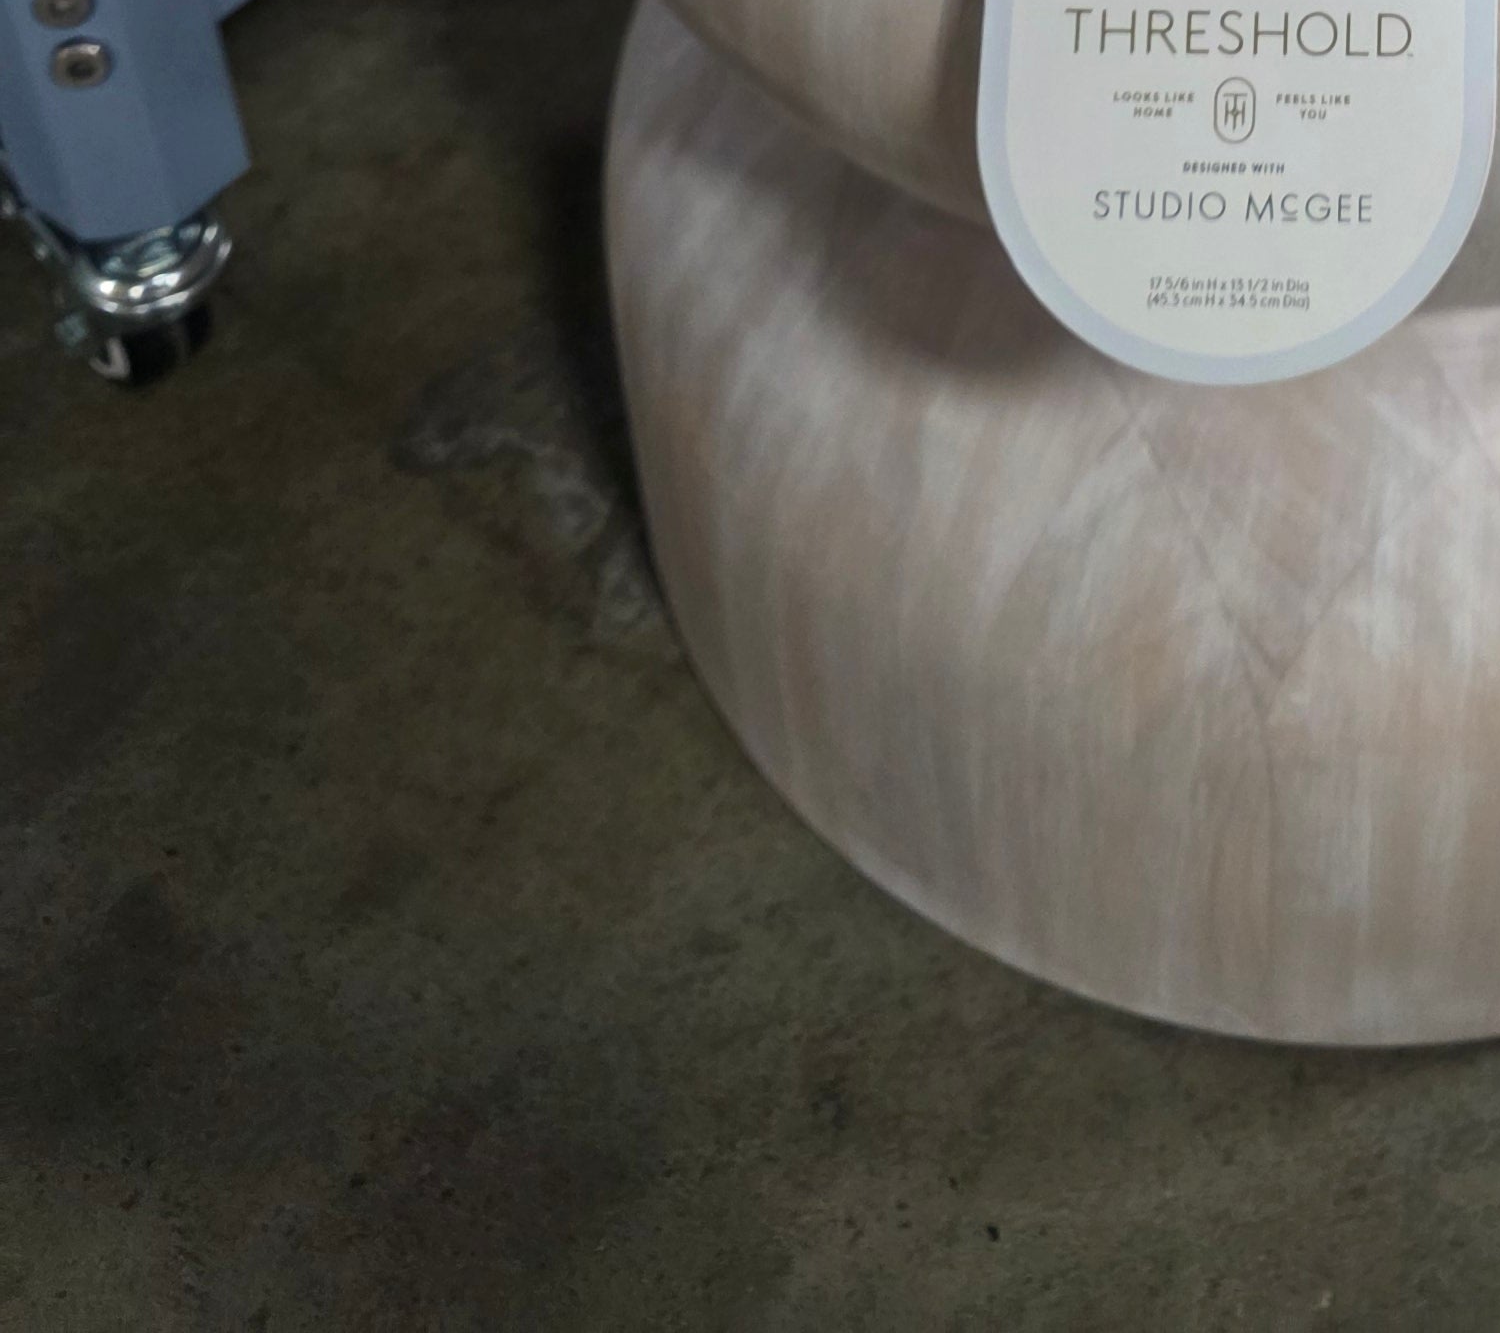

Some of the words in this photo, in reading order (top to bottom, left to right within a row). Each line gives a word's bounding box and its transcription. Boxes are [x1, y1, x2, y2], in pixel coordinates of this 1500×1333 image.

[1063, 7, 1413, 58] THRESHOLD
[1112, 91, 1160, 104] LOOKS
[1164, 91, 1196, 104] LIKE
[1275, 92, 1317, 106] FEELS
[1320, 93, 1351, 106] LIKE
[1133, 106, 1173, 119] HOME
[1299, 108, 1327, 121] YOU
[1182, 160, 1247, 175] DESIGNED
[1251, 161, 1285, 175] WITH
[1093, 189, 1227, 222] STUDIO
[1149, 276, 1163, 291] 17
[1191, 278, 1205, 291] in
[1206, 277, 1218, 292] H
[1219, 281, 1227, 292] x
[1247, 278, 1269, 293] 1/2
[1270, 279, 1284, 293] in
[1285, 278, 1310, 294] Dia
[1182, 295, 1203, 308] cm
[1204, 292, 1216, 308] H
[1217, 296, 1225, 308] x
[1259, 296, 1281, 308] cm
[1282, 293, 1311, 312] Dia)
